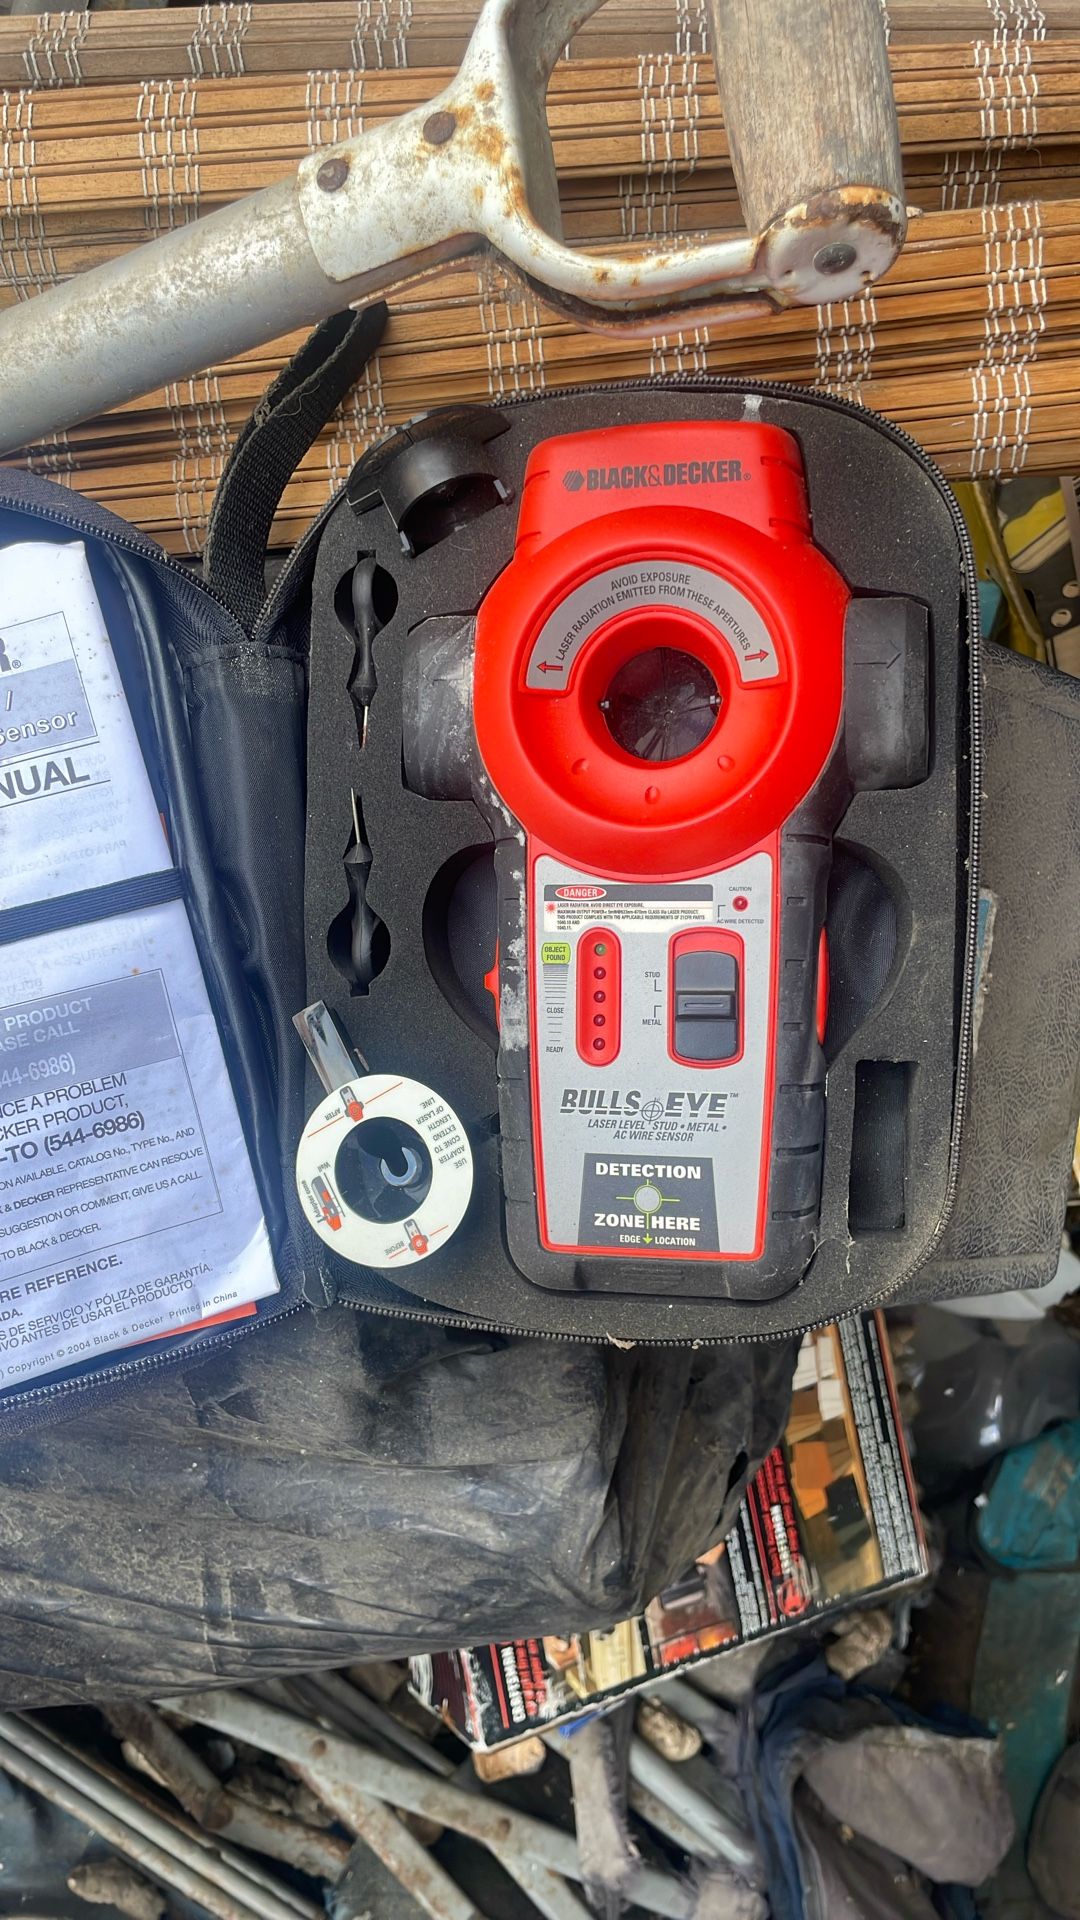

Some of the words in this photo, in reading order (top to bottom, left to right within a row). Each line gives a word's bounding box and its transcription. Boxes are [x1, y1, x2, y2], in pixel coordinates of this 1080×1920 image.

[610, 574, 638, 591] AVOID
[640, 571, 691, 586] EXPOSURE
[556, 630, 576, 661] LASER
[574, 596, 616, 634] RADIATION
[615, 585, 656, 602] EMITTED
[658, 584, 686, 598] FROM
[686, 588, 715, 610] THESE
[713, 604, 751, 652] APERTURES
[563, 887, 598, 897] DANGER
[544, 946, 566, 954] OBJECT
[4, 997, 92, 1032] PRODUCT
[33, 1021, 80, 1043] CALL
[0, 1052, 76, 1088] 44-6986)
[31, 1096, 43, 1110] A
[44, 1073, 127, 1106] PROBLEM
[560, 1089, 641, 1117] BULLS
[43, 1093, 129, 1128] PRODUCT,
[325, 1106, 341, 1121] AFTER
[416, 1111, 435, 1126] LASER
[428, 1113, 453, 1132] LENGTH
[44, 1110, 145, 1156] (544-6986)
[432, 1123, 457, 1141] EXTEND
[587, 1119, 617, 1129] LASER
[618, 1120, 645, 1130] LEVEL
[652, 1121, 678, 1131] STUD
[687, 1122, 719, 1132] METAL
[613, 1130, 627, 1139] AC
[629, 1131, 653, 1141] WIRE
[655, 1132, 694, 1142] SENSOR
[15, 1164, 67, 1187] AVAILABLE,
[68, 1150, 112, 1170] CATALOG
[131, 1138, 156, 1152] TYPE
[175, 1127, 195, 1140] AND
[438, 1145, 466, 1165] ADAPTER
[455, 1157, 468, 1169] USE
[5, 1203, 12, 1213] &
[13, 1190, 55, 1210] DECKER
[56, 1166, 139, 1197] REPRESENTATIVE
[139, 1159, 160, 1173] CAN
[161, 1147, 204, 1167] RESOLVE
[595, 1162, 701, 1180] DETECTION
[0, 1211, 63, 1238] SUGGESTION
[64, 1205, 80, 1217] OR
[80, 1190, 131, 1213] COMMENT,
[131, 1184, 155, 1197] GIVE
[155, 1179, 170, 1191] US
[170, 1178, 178, 1187] A
[594, 1213, 645, 1228] ZONE
[651, 1215, 701, 1231] HERE
[1, 1249, 16, 1261] TO
[17, 1239, 50, 1256] BLACK
[51, 1236, 58, 1246] &
[59, 1223, 102, 1243] DECKER.
[619, 1234, 641, 1244] EDGE
[654, 1236, 696, 1246] LOCATION
[24, 1254, 123, 1296] REFERENCE.
[0, 1308, 23, 1321] DA.
[9, 1323, 27, 1337] DE
[28, 1305, 84, 1331] SERVICIO
[84, 1301, 93, 1311] Y
[95, 1287, 137, 1309] PÓLIZA
[136, 1281, 153, 1294] DE
[7, 1353, 54, 1375] Copyright
[67, 1340, 91, 1355] 2004
[93, 1331, 120, 1345] Black
[122, 1328, 129, 1336] &
[131, 1315, 164, 1332] Decker
[168, 1303, 201, 1319] Printed
[213, 1291, 238, 1304] China
[21, 1325, 60, 1345] ANTES
[62, 1317, 79, 1331] DE
[80, 1306, 114, 1325] USAR
[114, 1301, 130, 1313] EL
[500, 1645, 526, 1723] CRAFTSMAN
